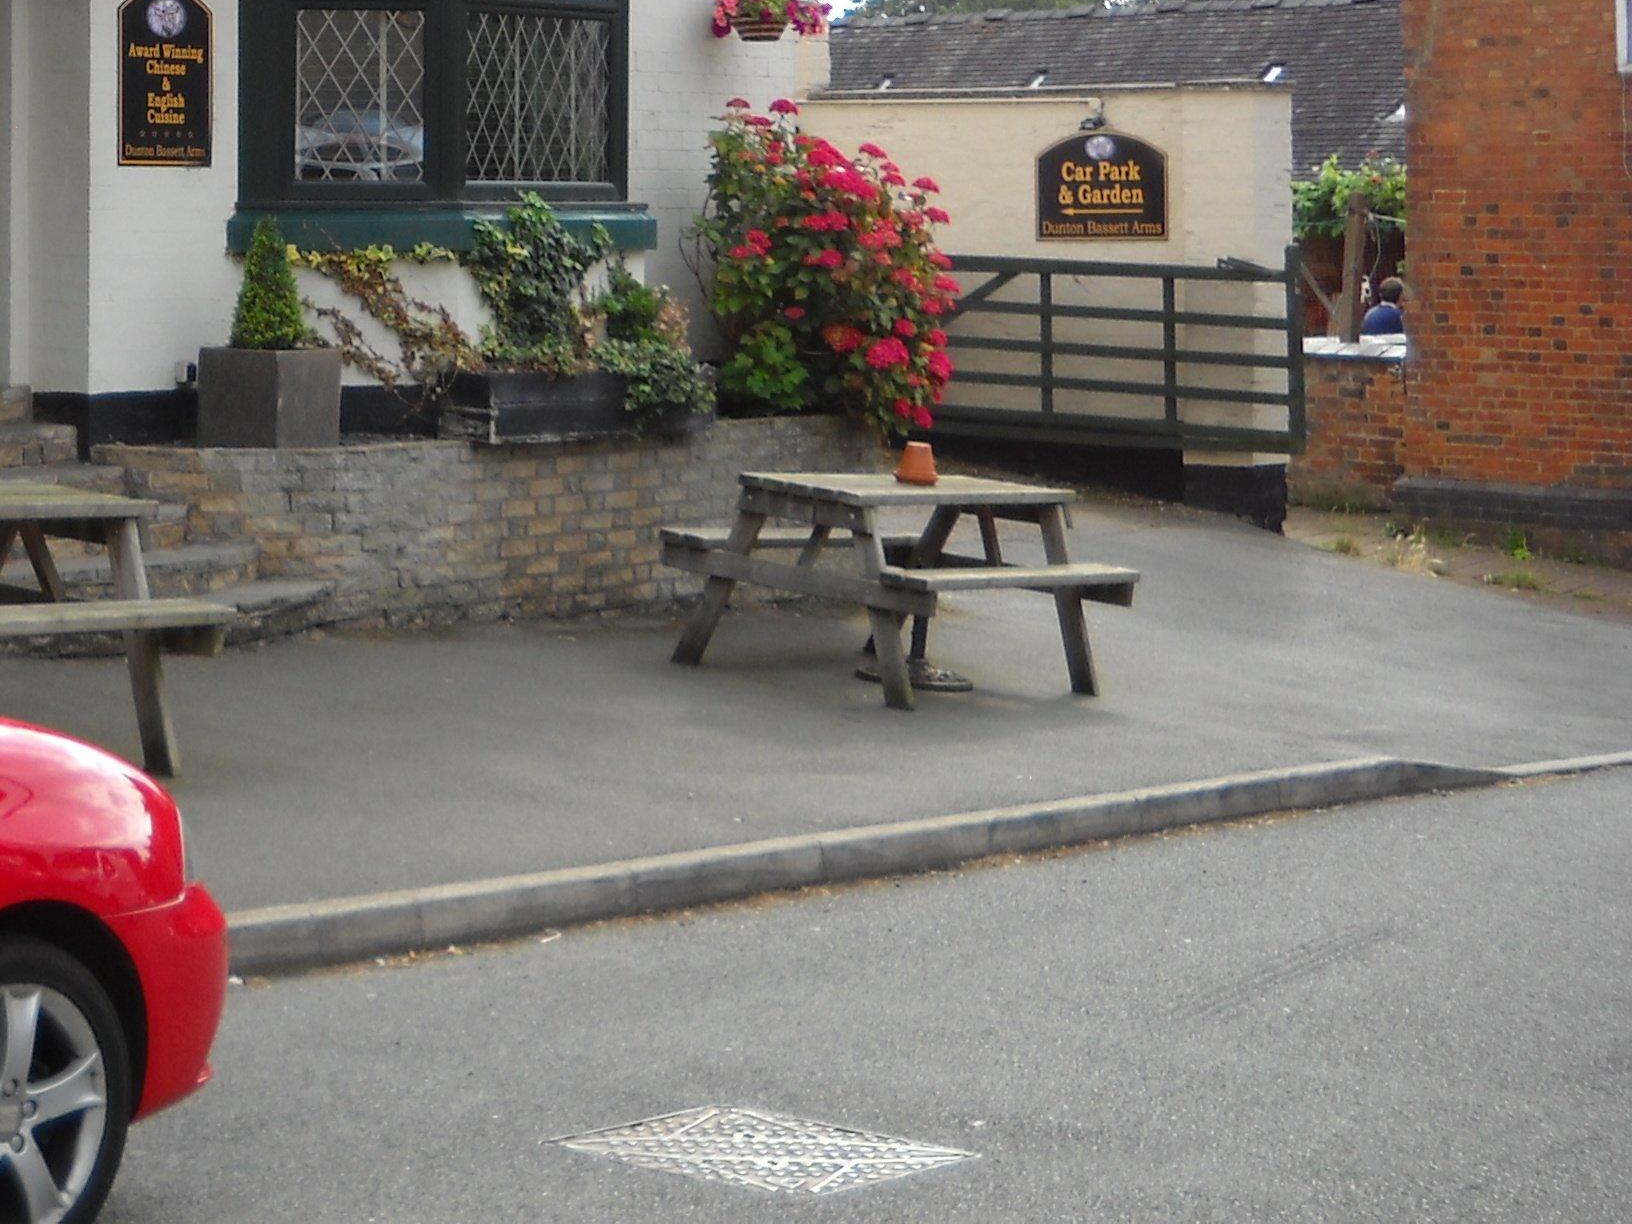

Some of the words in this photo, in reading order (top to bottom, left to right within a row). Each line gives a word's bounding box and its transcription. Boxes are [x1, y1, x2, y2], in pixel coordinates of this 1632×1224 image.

[128, 42, 160, 57] Award
[162, 43, 205, 63] Winning
[146, 60, 186, 75] Chinese
[162, 76, 171, 91] &
[147, 92, 185, 112] English
[147, 109, 185, 124] Cuisine
[1061, 161, 1093, 182] Car
[1098, 159, 1141, 182] Park
[1058, 184, 1074, 205] &
[1078, 183, 1144, 205] Garden
[1042, 221, 1085, 235] Dunton
[1087, 220, 1129, 235] Bassett
[1132, 220, 1163, 235] Arms
